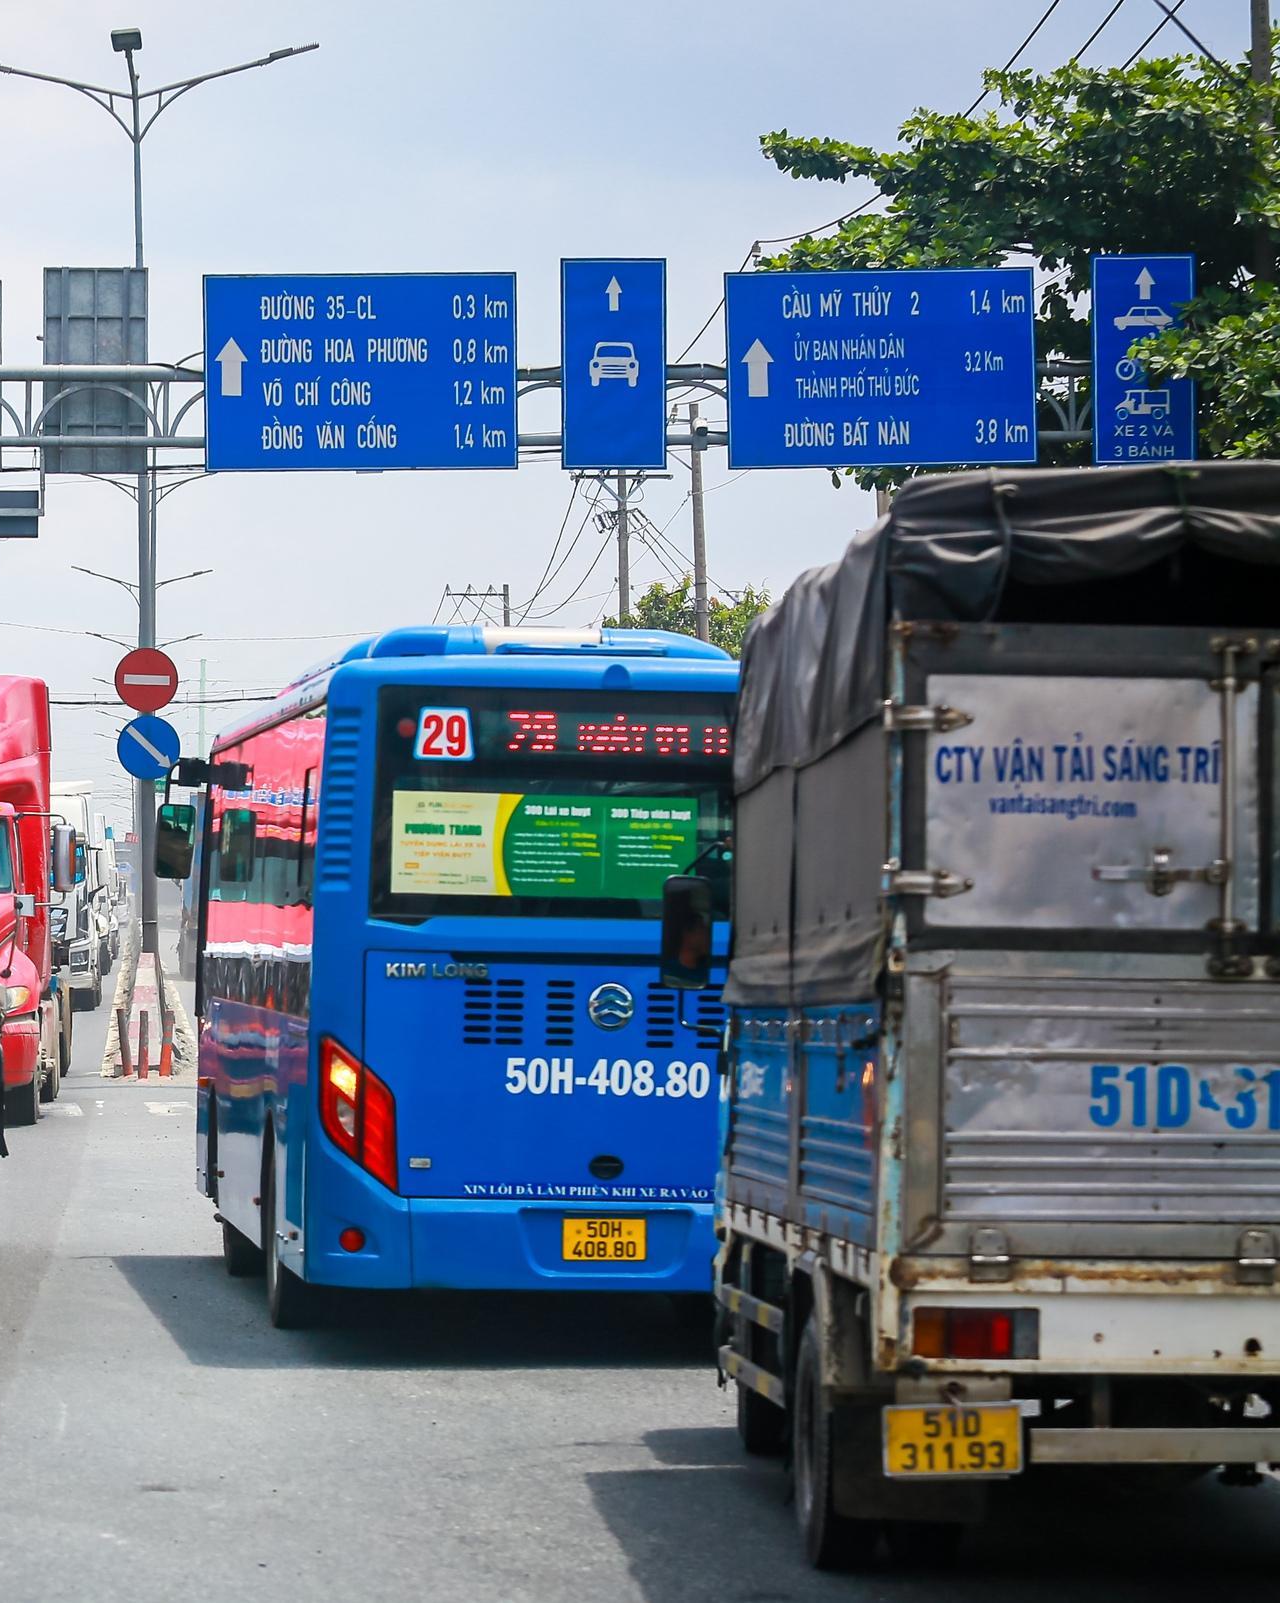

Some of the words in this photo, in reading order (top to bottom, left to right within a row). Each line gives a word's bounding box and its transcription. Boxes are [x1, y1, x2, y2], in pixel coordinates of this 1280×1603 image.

[260, 290, 314, 320] ĐƯỜNG
[326, 295, 377, 320] 35-CL
[453, 295, 476, 320] 0,3
[485, 295, 508, 318] km
[782, 285, 811, 319] CẦU
[820, 289, 842, 317] MỸ
[853, 286, 892, 316] THỦY
[910, 292, 920, 316] 2
[970, 290, 991, 316] 1,4
[1002, 290, 1025, 314] km
[260, 333, 312, 363] ĐƯỜNG
[324, 338, 355, 362] HOA
[368, 337, 428, 362] PHƯƠNG
[453, 339, 476, 364] 0,8
[485, 340, 508, 363] km
[794, 333, 813, 361] ỦY
[813, 340, 838, 361] BAN
[879, 332, 905, 359] DÂN
[965, 351, 981, 373] 3,2
[984, 351, 1004, 371] Km
[262, 377, 282, 405] VÕ
[295, 376, 321, 405] CHÍ
[331, 378, 371, 405] CÔNG
[454, 381, 473, 406] 1,2
[481, 381, 505, 405] km
[795, 370, 837, 399] THÀNH
[840, 366, 866, 397] PHỐ
[867, 367, 891, 397] THỦ
[895, 368, 920, 396] ĐỨC
[261, 416, 303, 450] ĐỒNG
[316, 420, 345, 449] VĂN
[357, 416, 397, 448] CỐNG
[454, 424, 474, 449] 1,4
[483, 424, 506, 448] km
[784, 416, 834, 447] ĐƯỜNG
[843, 416, 869, 446] BÁT
[878, 415, 910, 445] NÀN
[975, 419, 997, 445] 3,8
[1005, 420, 1028, 443] km
[1114, 425, 1135, 437] XE
[1139, 426, 1148, 437] 2
[1153, 420, 1174, 437] VÀ
[1114, 446, 1123, 457] 3
[1128, 442, 1174, 457] BÁNH
[422, 714, 467, 756] 29
[935, 745, 984, 783] CTY
[993, 737, 1044, 790] VẬN
[1053, 732, 1095, 783] TẢI
[1103, 739, 1170, 783] SÁNG
[988, 793, 1137, 820] vantaisangtri.com
[386, 963, 426, 978] KIM
[432, 964, 489, 979] LONG
[505, 1057, 711, 1099] 50H-408.80
[464, 1185, 486, 1194] XIN
[537, 1183, 566, 1196] LÀM
[612, 1187, 636, 1197] KHI
[640, 1187, 657, 1198] XE
[660, 1188, 678, 1198] RA
[680, 1187, 709, 1199] VÀO
[586, 1220, 622, 1238] 50H
[572, 1241, 637, 1258] 408.80
[923, 1410, 981, 1438] 51D
[900, 1441, 1006, 1471] 311.93
